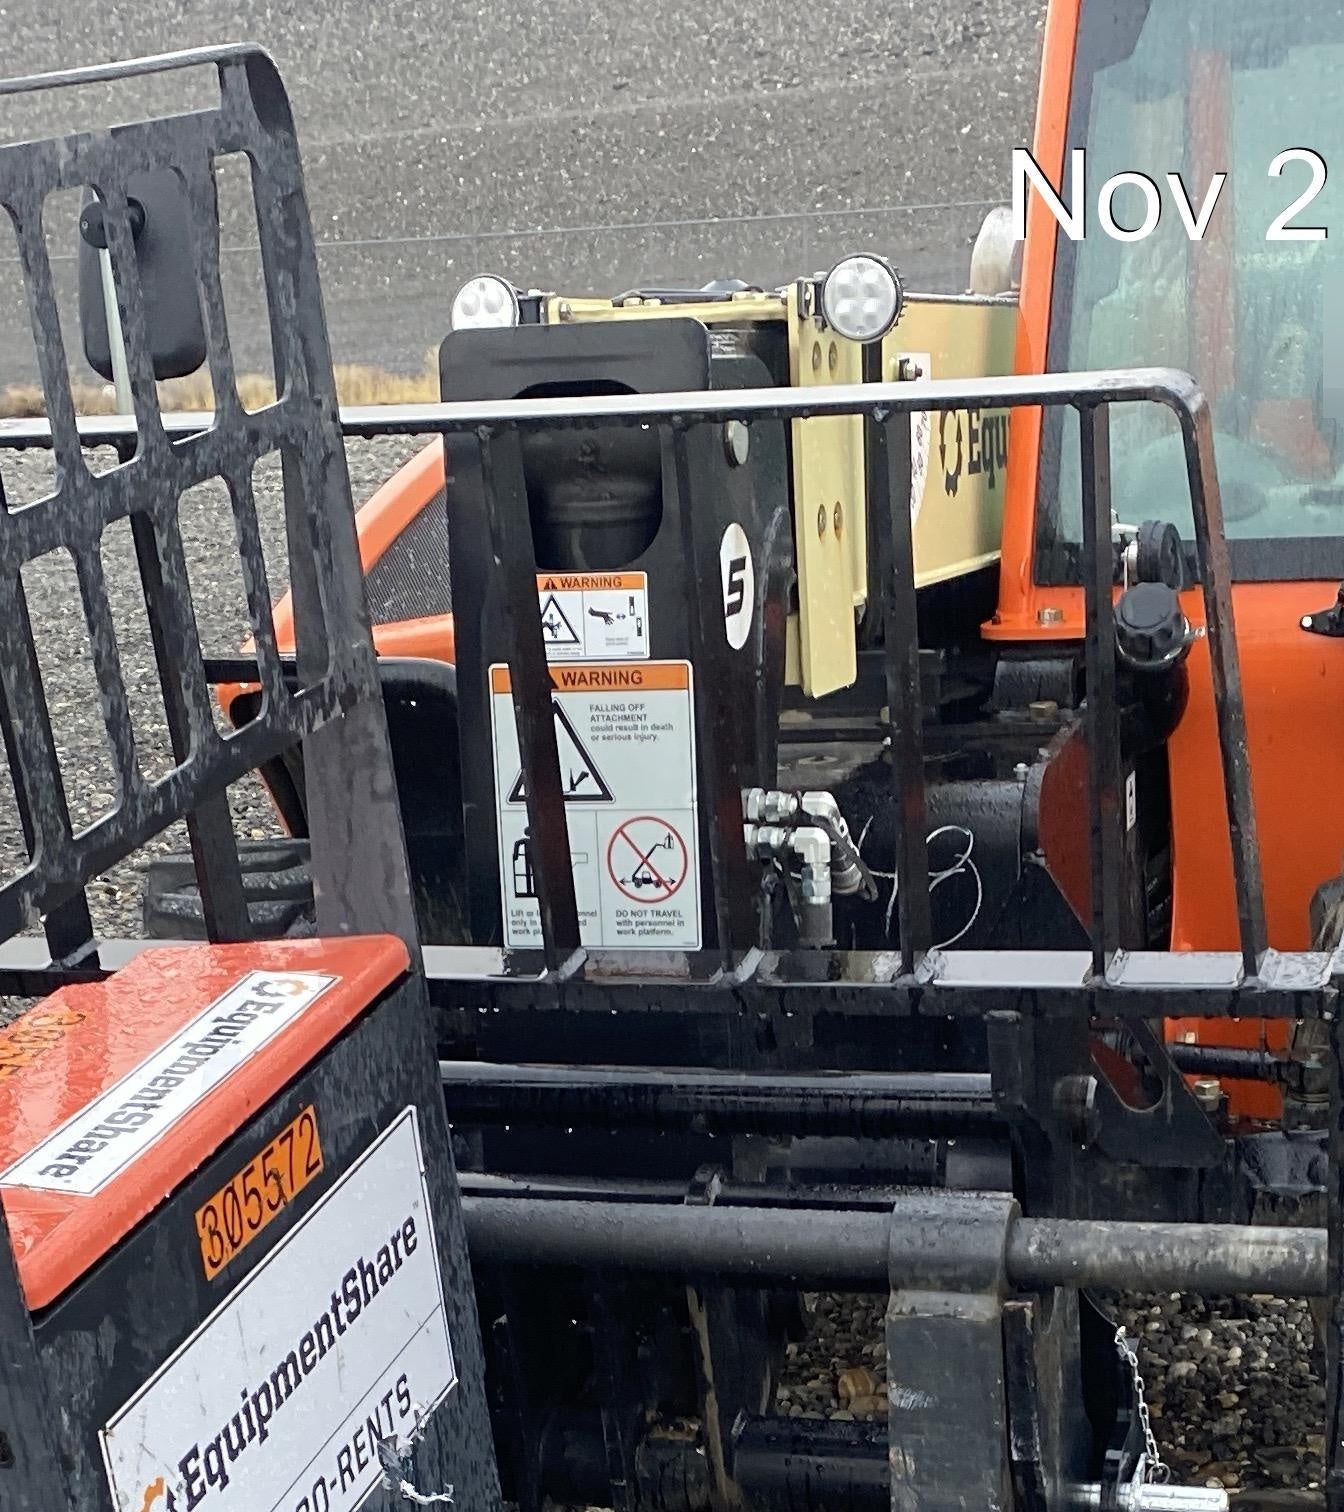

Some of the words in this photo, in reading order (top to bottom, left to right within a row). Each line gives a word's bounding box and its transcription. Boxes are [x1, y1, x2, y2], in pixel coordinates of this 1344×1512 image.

[560, 576, 622, 589] WARNING
[561, 669, 643, 687] WARNING
[589, 703, 626, 712] FALLING
[628, 703, 645, 712] OFF
[590, 713, 647, 723] ATTACHMENT
[590, 723, 613, 733] could
[615, 722, 639, 732] result
[640, 722, 649, 731] in
[650, 721, 674, 732] death
[601, 733, 632, 742] serious
[615, 909, 629, 918] DO
[631, 909, 648, 918] NOT
[649, 909, 683, 918] TRAVEL
[616, 920, 633, 928] with
[635, 919, 675, 930] personnel
[616, 928, 636, 936] work
[38, 999, 285, 1182] EquipmentShare
[202, 1112, 321, 1269] 305572
[178, 1215, 418, 1512] EquipmentShare
